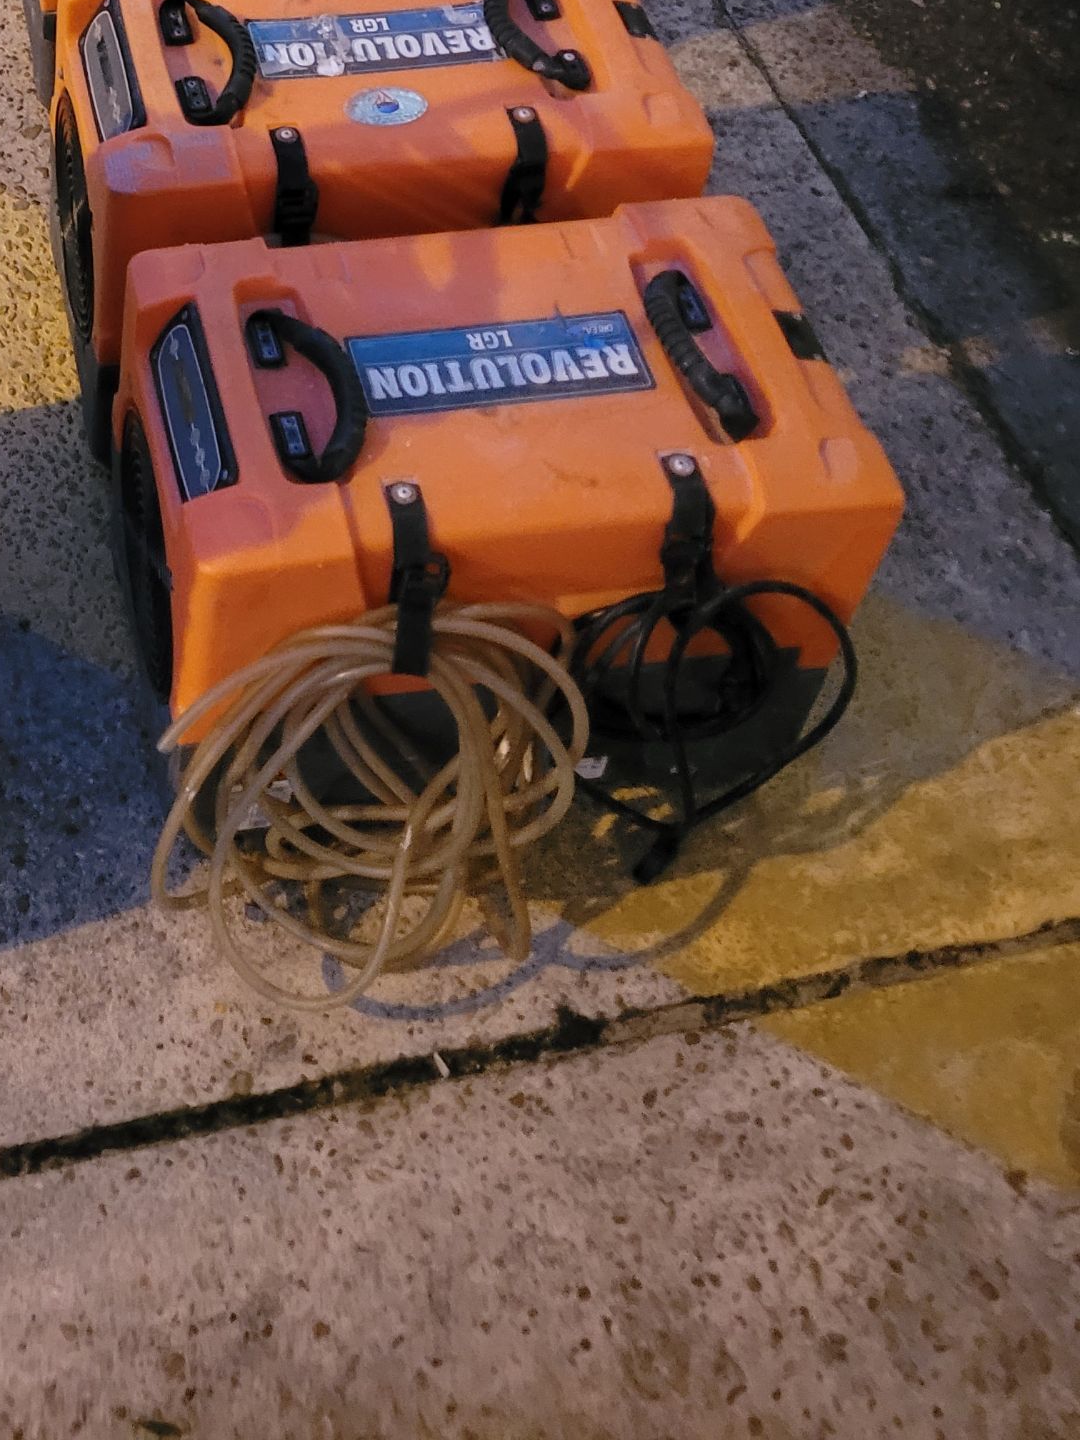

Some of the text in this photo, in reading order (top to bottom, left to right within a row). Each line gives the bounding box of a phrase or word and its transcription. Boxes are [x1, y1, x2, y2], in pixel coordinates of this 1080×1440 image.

[349, 17, 390, 33] LGR
[466, 329, 513, 351] LGR
[365, 344, 639, 400] REVOLUTION
